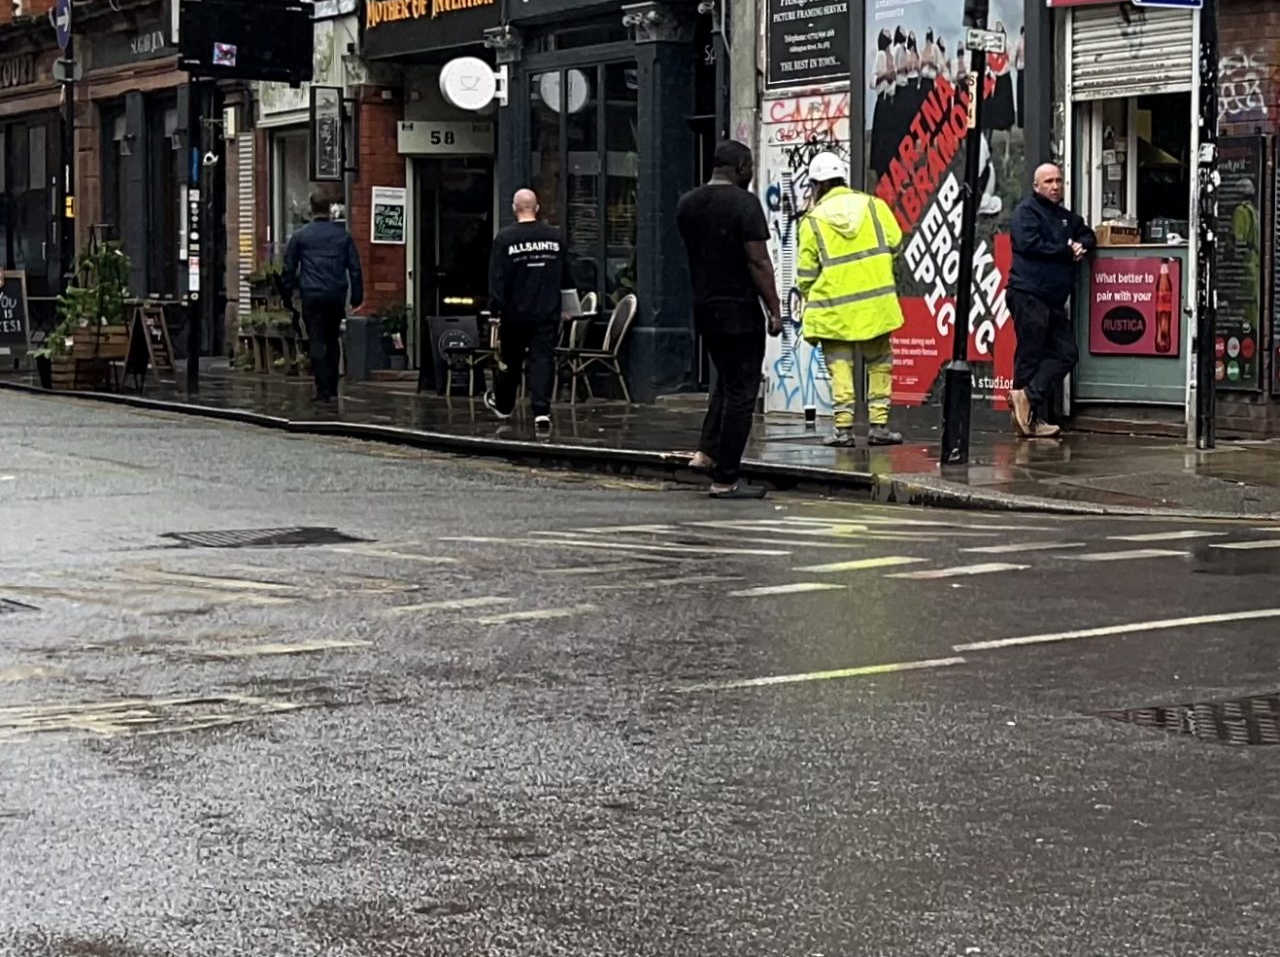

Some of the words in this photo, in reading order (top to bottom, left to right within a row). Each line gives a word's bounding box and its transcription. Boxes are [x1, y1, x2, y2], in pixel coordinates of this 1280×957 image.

[823, 2, 848, 17] SERVICE
[780, 61, 794, 72] THE
[794, 58, 809, 70] BEST
[809, 57, 818, 69] IN
[429, 130, 456, 146] 58
[875, 73, 956, 207] MARINA
[508, 241, 560, 256] ALLSAINTS
[937, 171, 1011, 330] BAKAN
[903, 230, 956, 337] EPIC
[920, 201, 996, 356] EROIC
[1095, 272, 1117, 284] What
[1118, 272, 1143, 284] better
[1144, 272, 1155, 284] to
[1096, 290, 1113, 303] pair
[1113, 290, 1132, 302] with
[1133, 292, 1152, 303] your
[1103, 319, 1144, 331] RUSTICA
